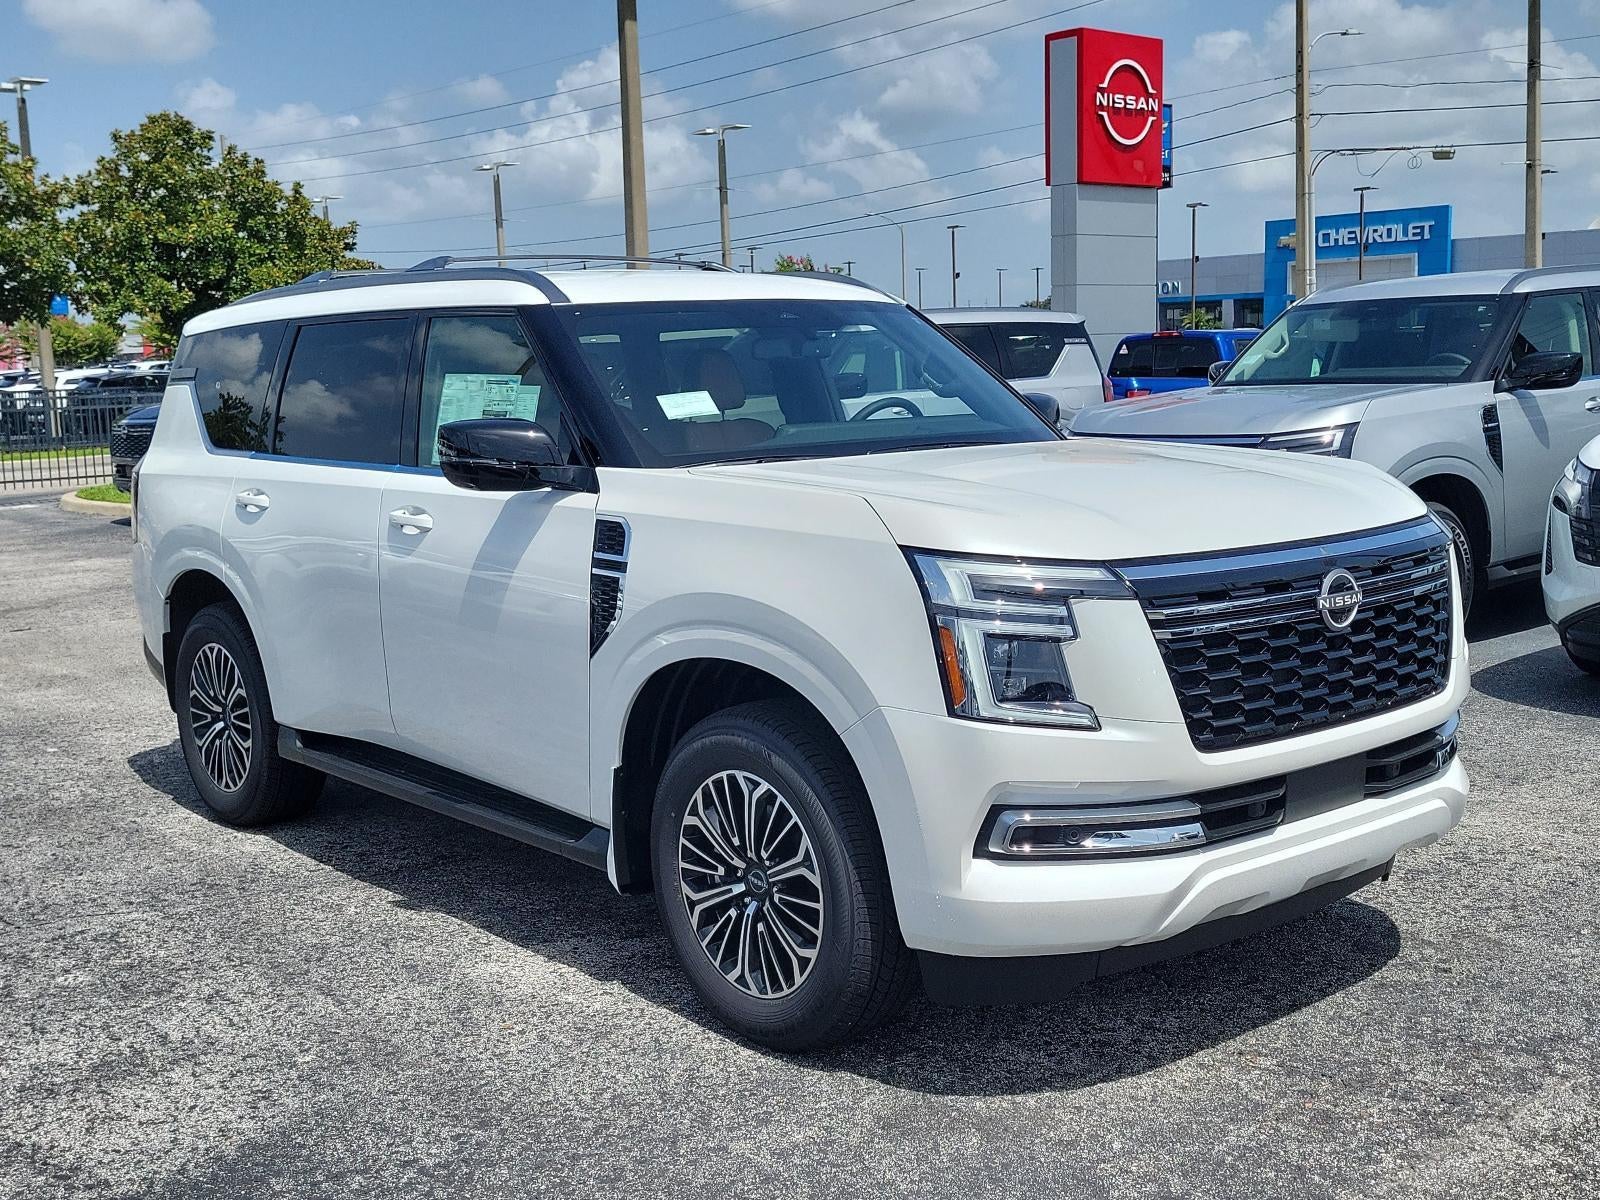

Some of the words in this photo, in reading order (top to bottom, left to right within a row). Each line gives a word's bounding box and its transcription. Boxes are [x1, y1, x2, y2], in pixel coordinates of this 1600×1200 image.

[1096, 91, 1159, 112] NISSAN
[1318, 220, 1435, 247] CHEVROLET
[1319, 590, 1363, 609] NISSAN
